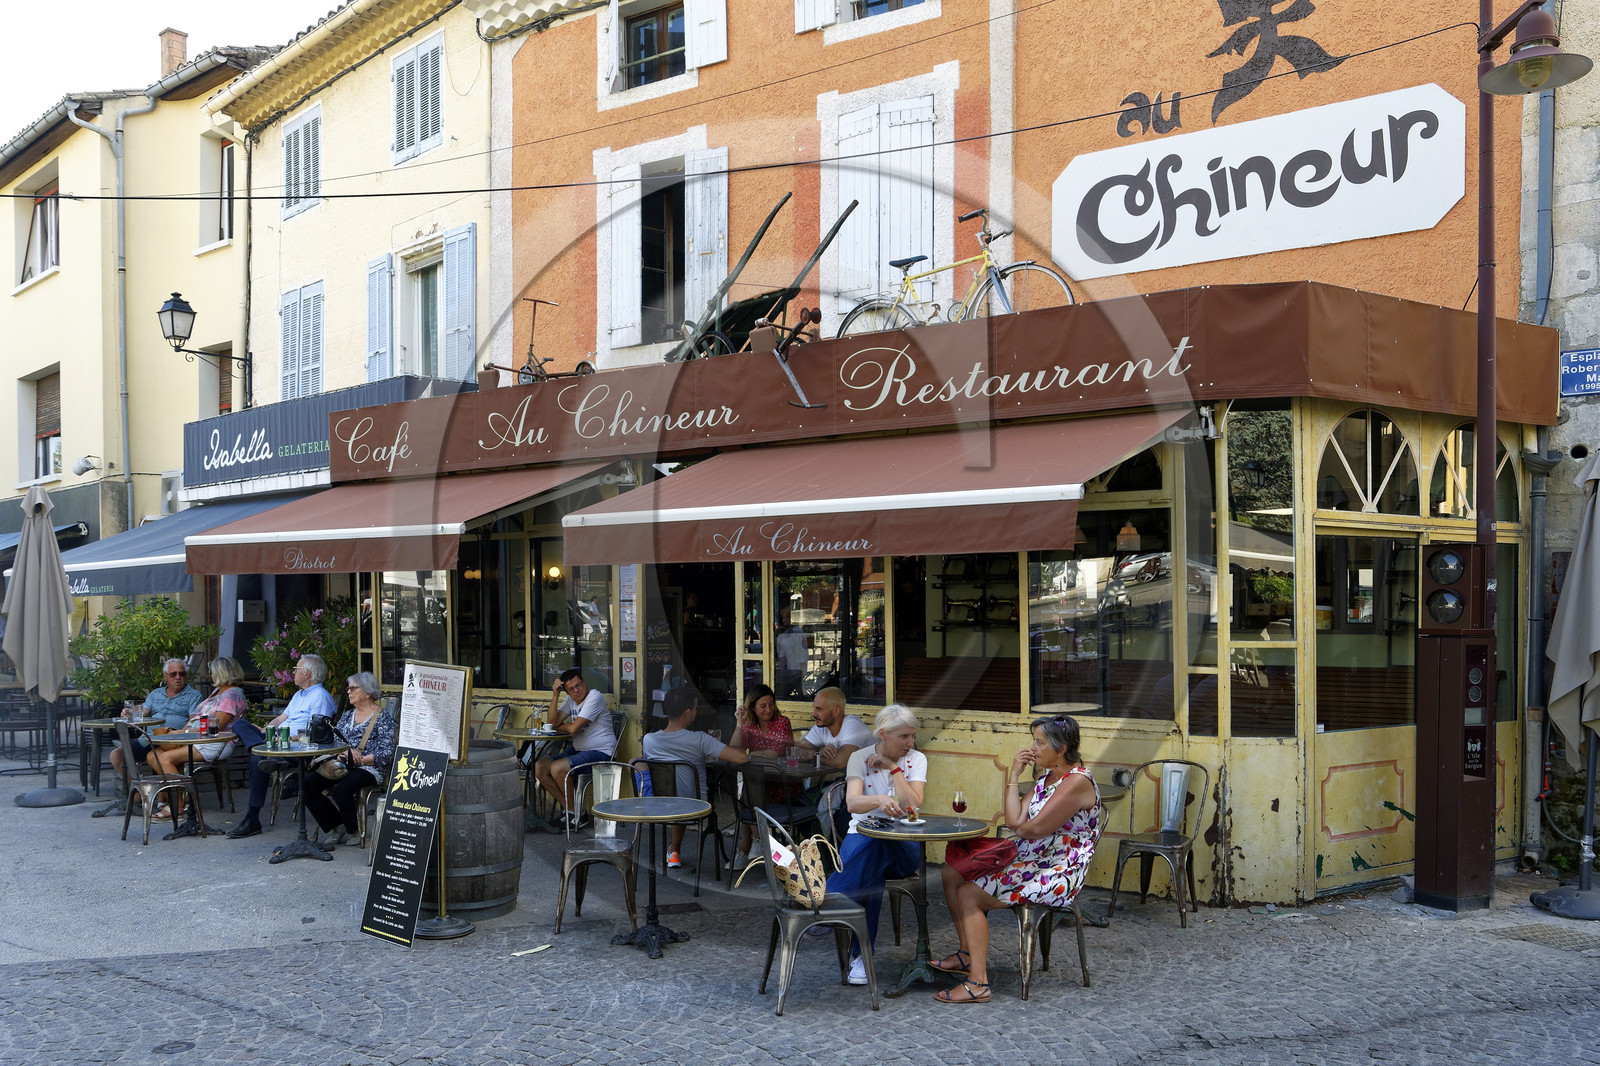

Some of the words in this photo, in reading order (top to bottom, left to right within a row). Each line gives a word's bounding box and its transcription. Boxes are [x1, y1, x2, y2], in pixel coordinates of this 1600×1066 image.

[1116, 90, 1182, 138] au
[1075, 110, 1439, 264] Chineur
[840, 336, 1193, 412] Restaurant
[1562, 364, 1600, 375] Rober
[478, 395, 549, 451] Au
[557, 384, 740, 439] Chineur
[203, 427, 273, 471] Isabella
[277, 439, 330, 458] GELATERIA
[334, 415, 413, 473] Café
[284, 547, 336, 570] Bistrot
[706, 525, 754, 556] Au
[759, 521, 873, 553] Chineur
[418, 679, 447, 692] CHINEUR
[410, 770, 443, 789] Chineur
